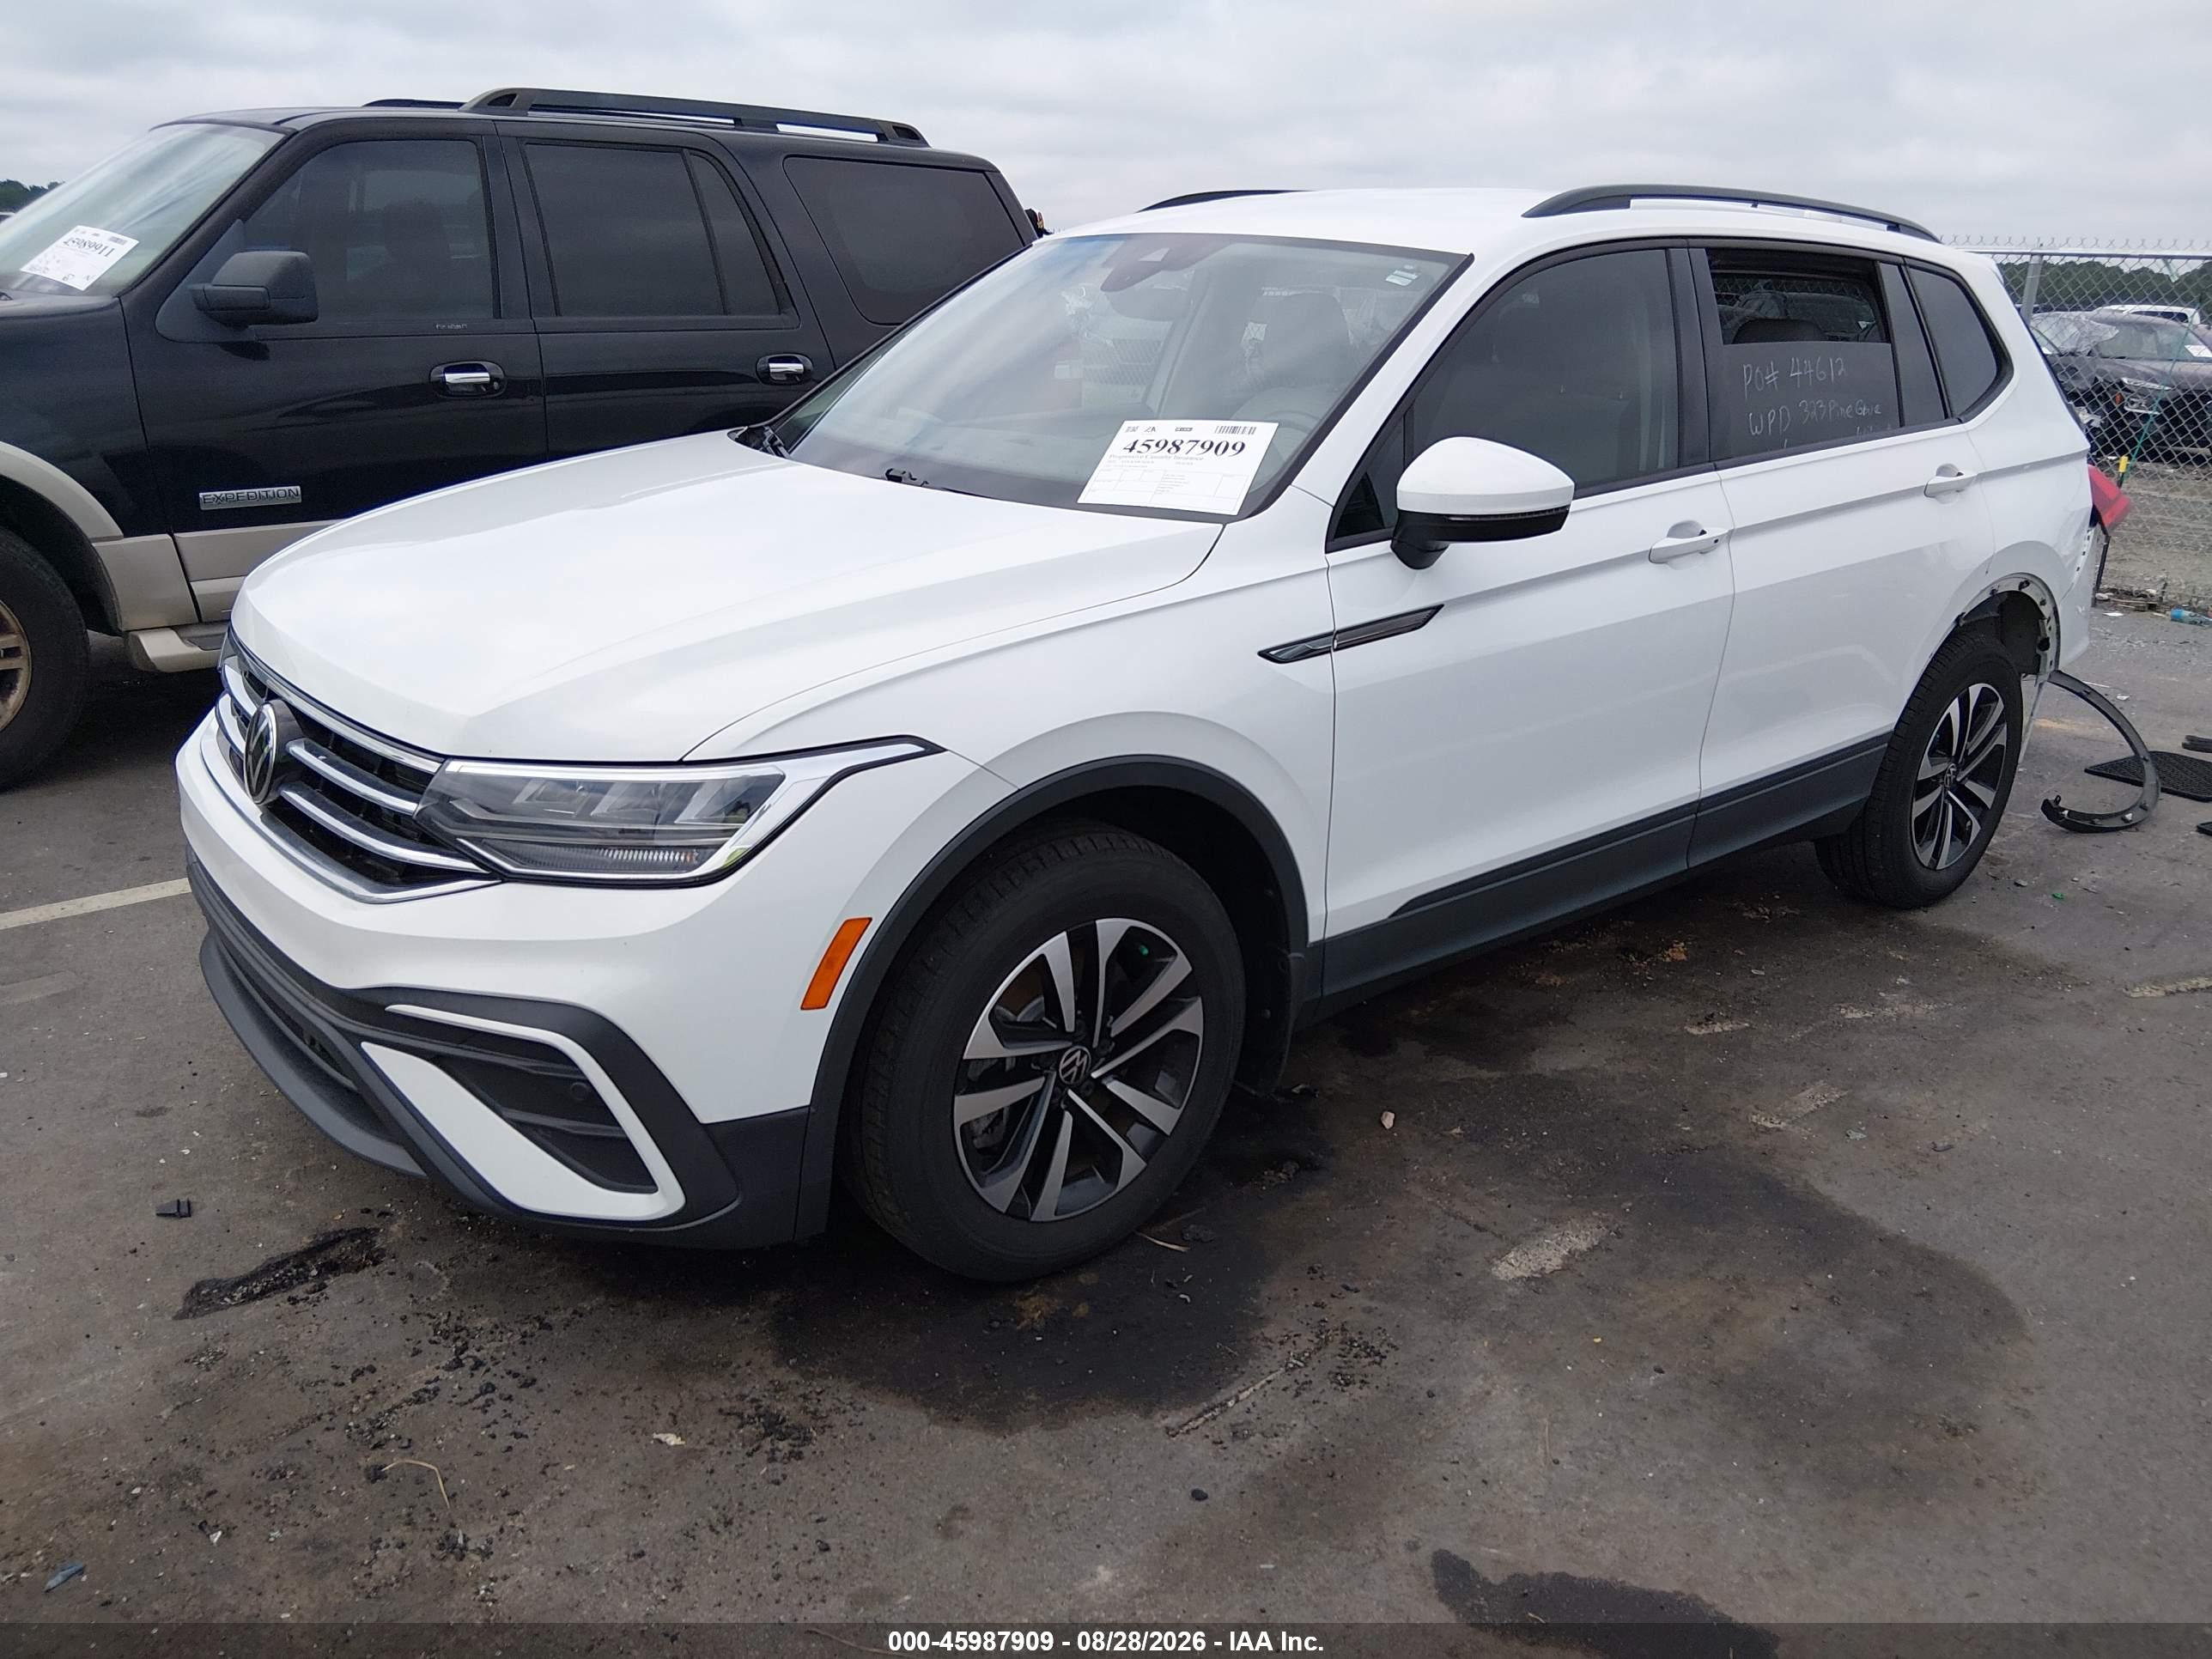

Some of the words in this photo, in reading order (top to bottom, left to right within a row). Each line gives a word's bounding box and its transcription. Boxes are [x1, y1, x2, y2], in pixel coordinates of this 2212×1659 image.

[1742, 361, 1779, 398] PO#
[1748, 405, 1791, 435] WPD
[1122, 439, 1246, 458] 45987909
[202, 488, 300, 504] EXPEDITION
